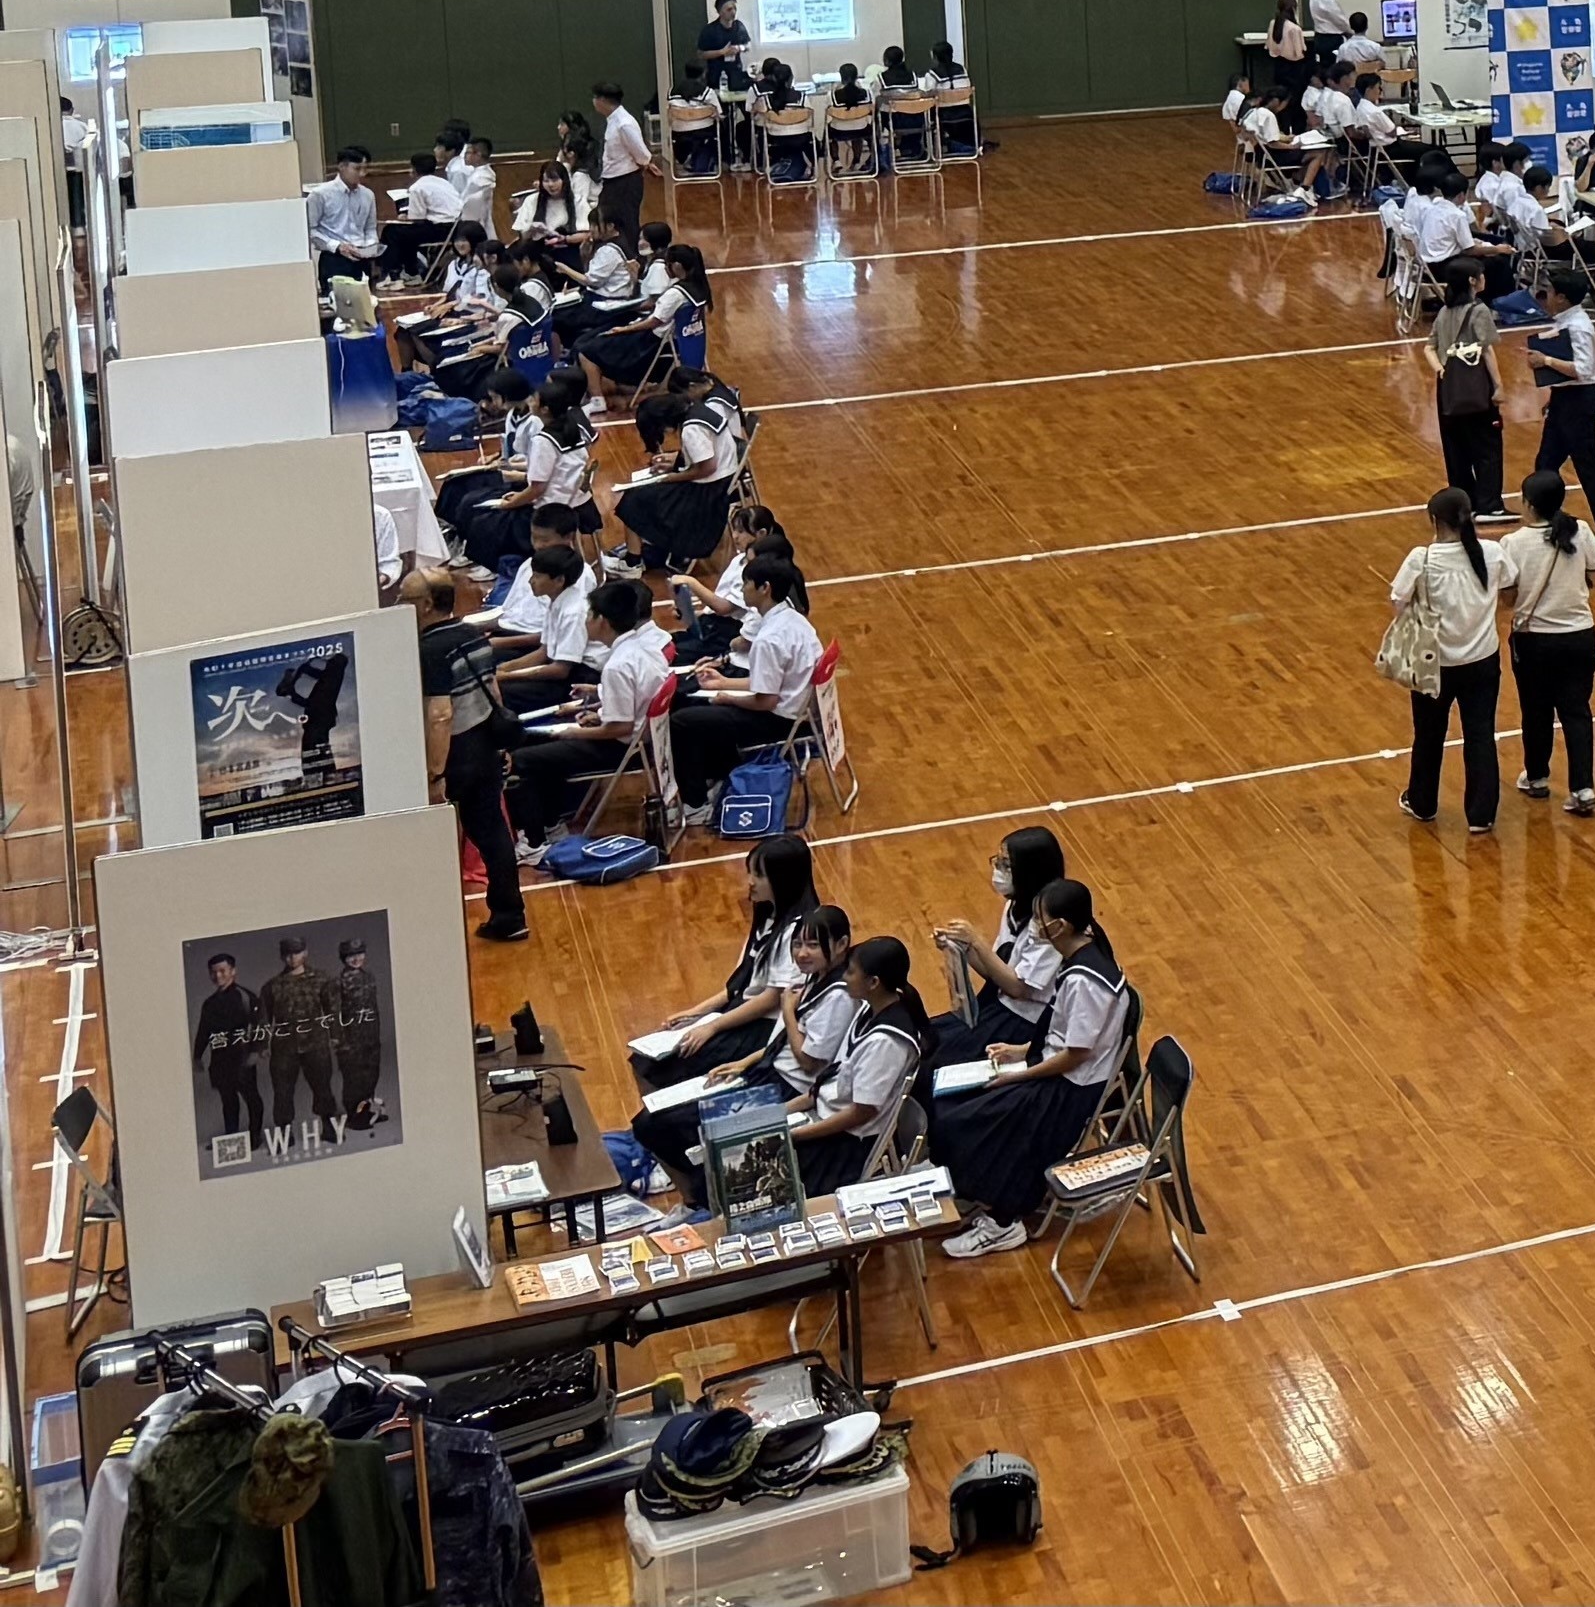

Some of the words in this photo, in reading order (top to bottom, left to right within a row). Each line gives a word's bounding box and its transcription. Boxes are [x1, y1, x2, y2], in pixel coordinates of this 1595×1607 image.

[208, 1007, 377, 1051] 答えがここでした
